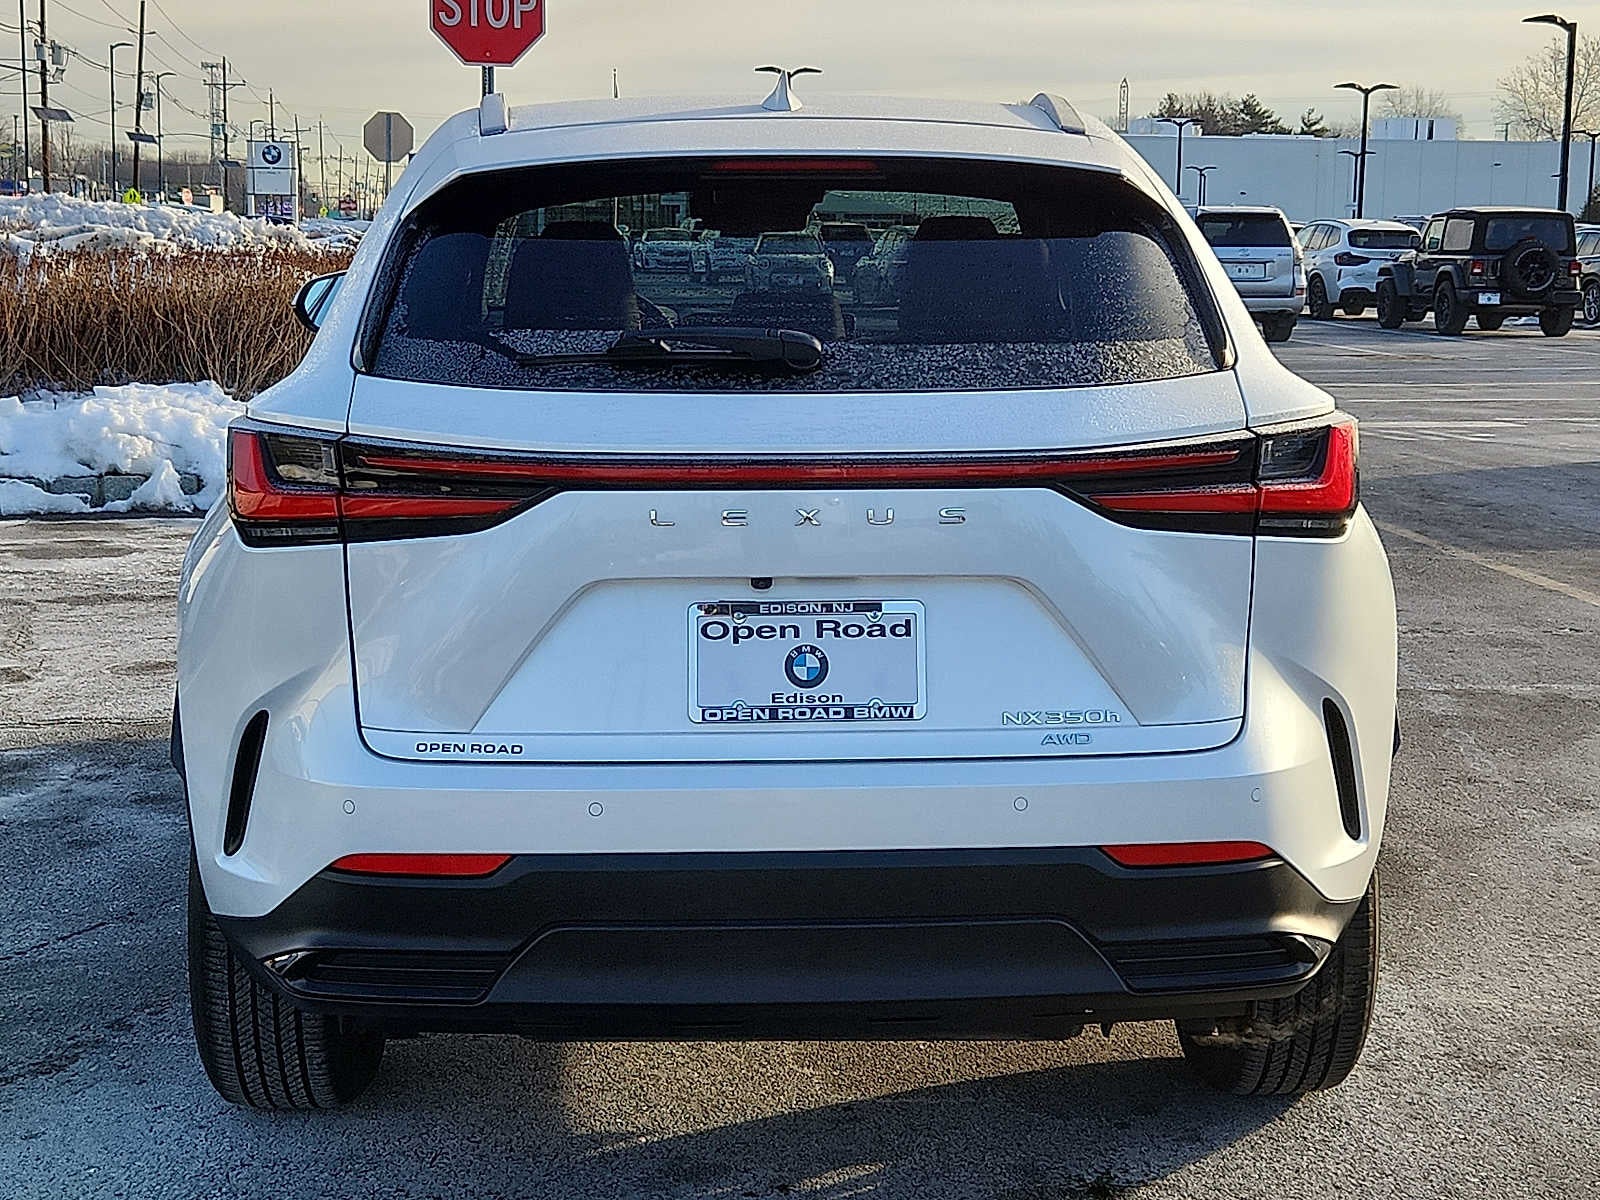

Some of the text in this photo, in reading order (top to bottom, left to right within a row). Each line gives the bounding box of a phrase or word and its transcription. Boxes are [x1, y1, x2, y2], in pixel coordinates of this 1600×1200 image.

[438, 0, 536, 28] STOP
[649, 507, 967, 527] LEXUS
[759, 602, 855, 614] EDISON, NJ
[700, 618, 912, 645] Open Road
[789, 645, 824, 659] BMW
[771, 692, 844, 704] Edison
[704, 706, 912, 721] OPEN ROAD BMW
[1041, 732, 1092, 746] AWD
[415, 742, 524, 755] OPEN ROAD
